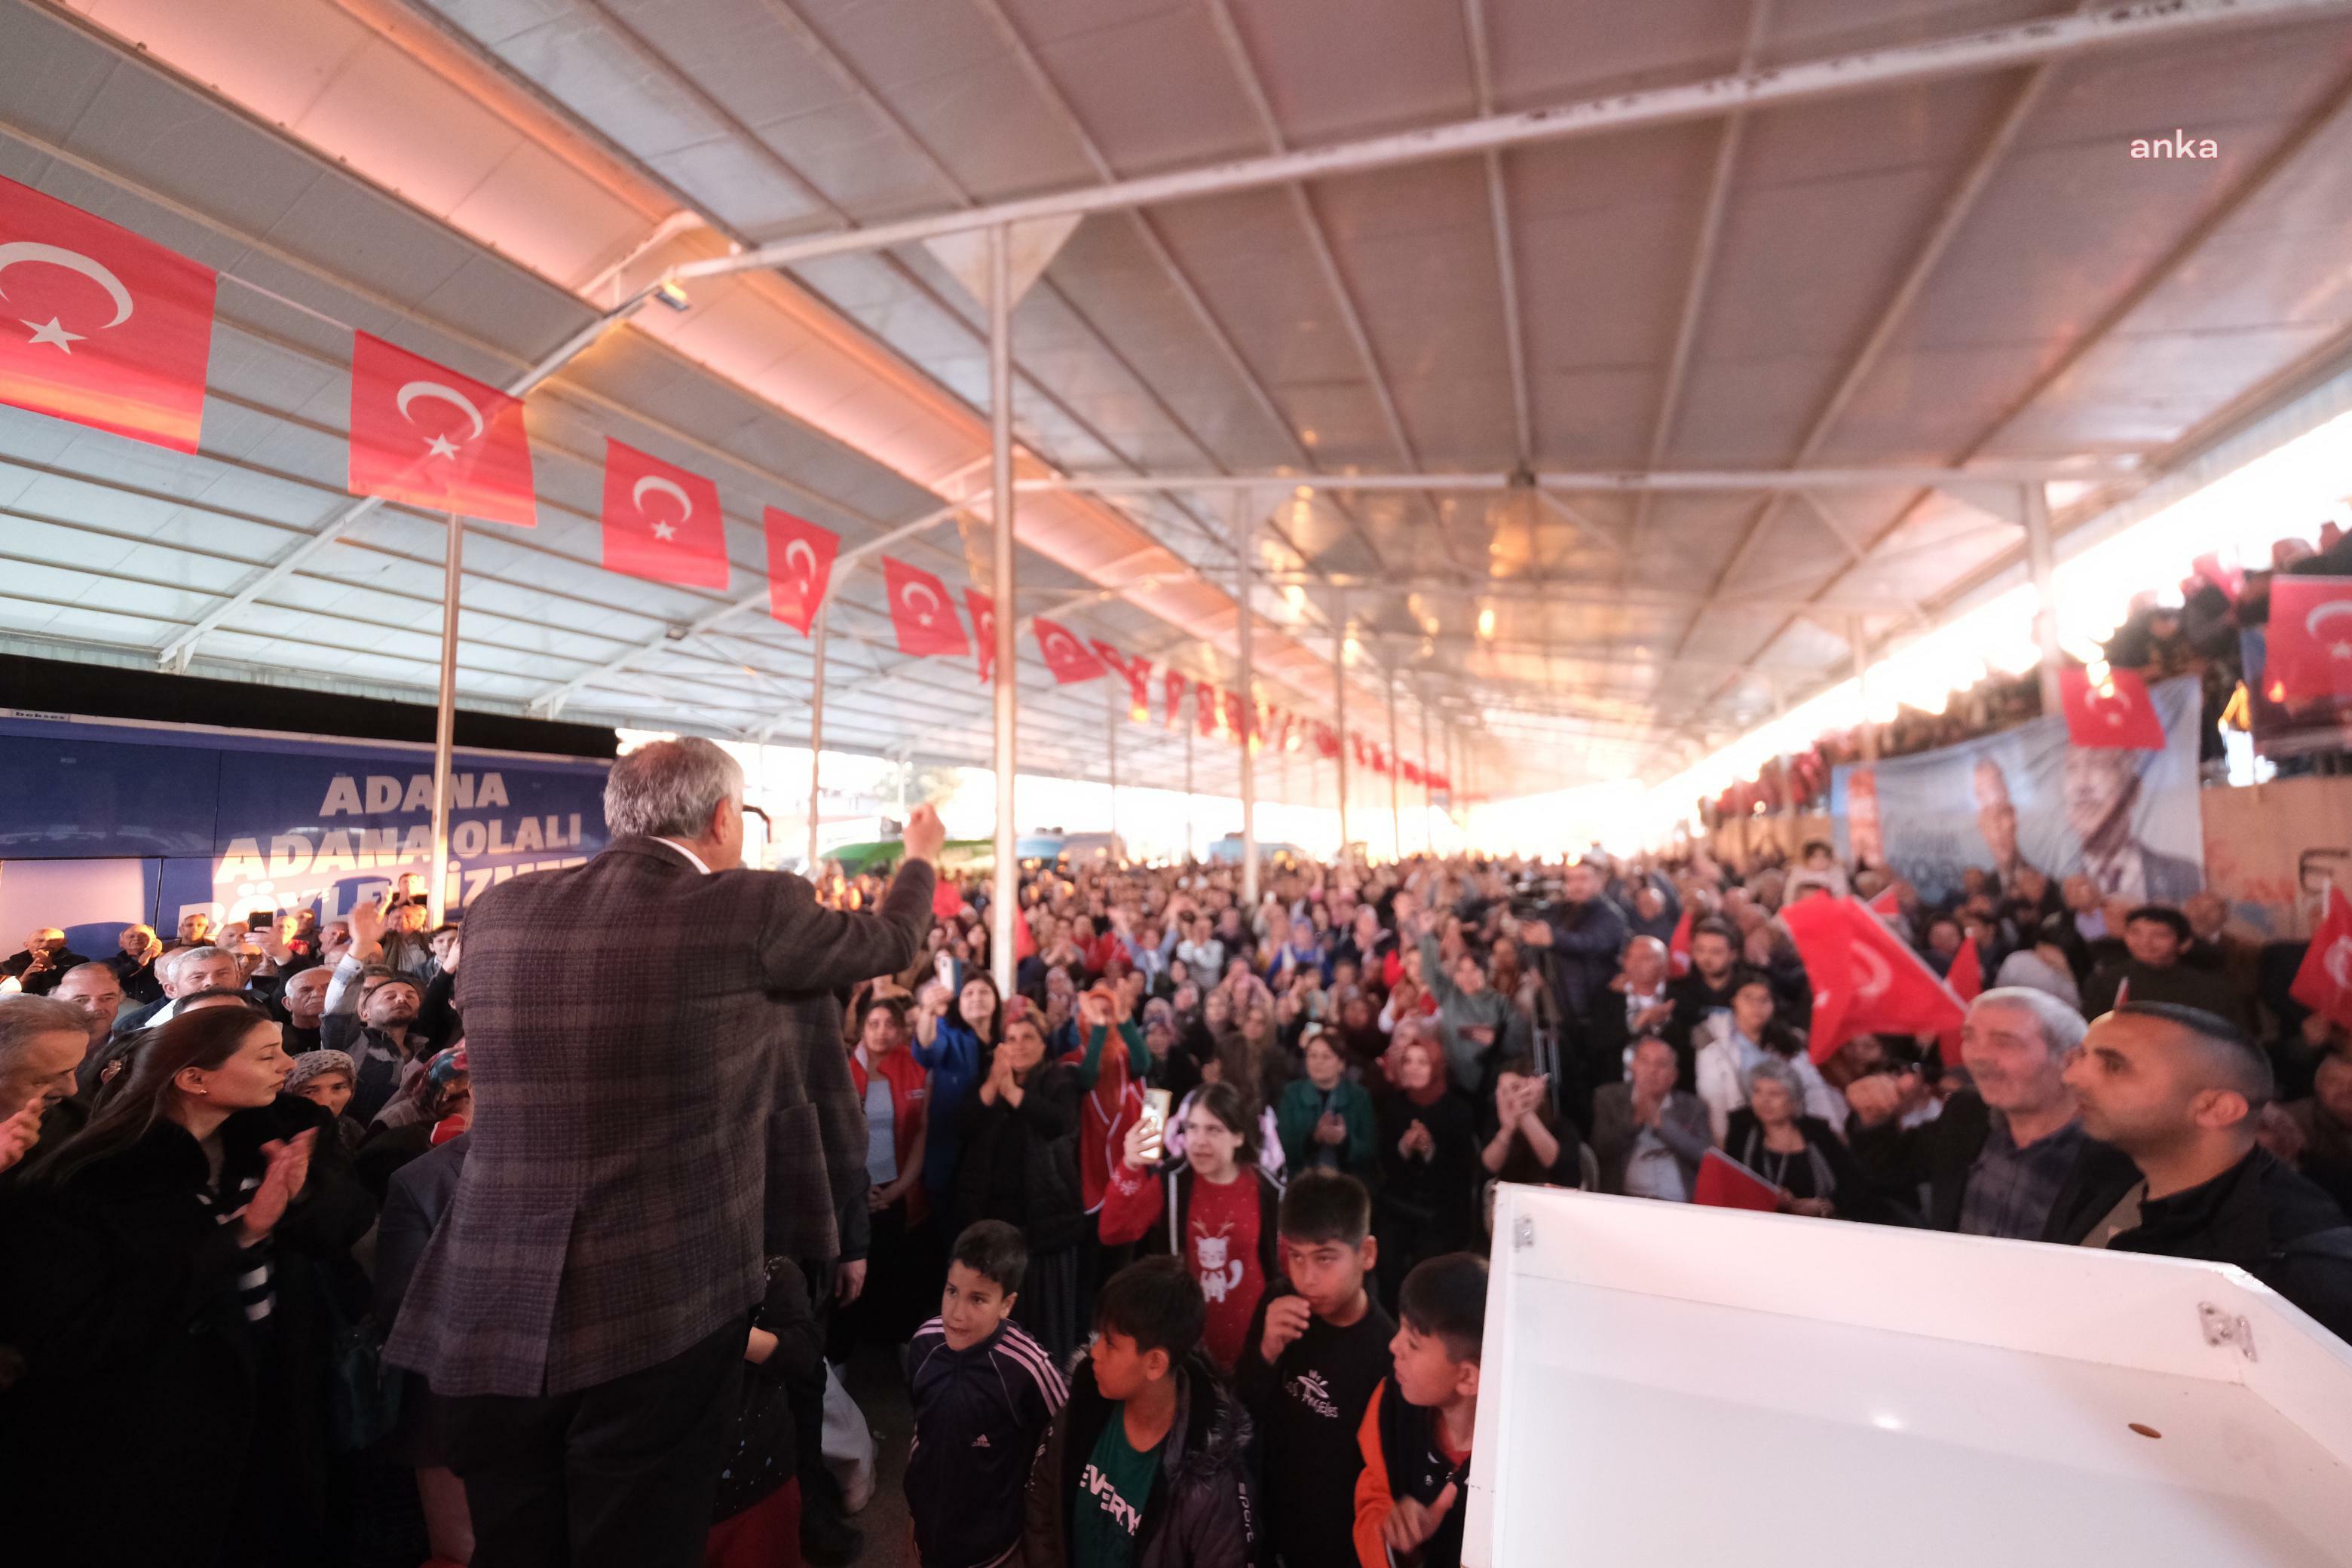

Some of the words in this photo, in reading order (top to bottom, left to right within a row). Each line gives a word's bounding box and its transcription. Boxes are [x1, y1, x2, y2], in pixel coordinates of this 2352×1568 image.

[319, 772, 510, 817] ADANA
[213, 824, 432, 885] ADANA
[452, 813, 581, 860] OLALI
